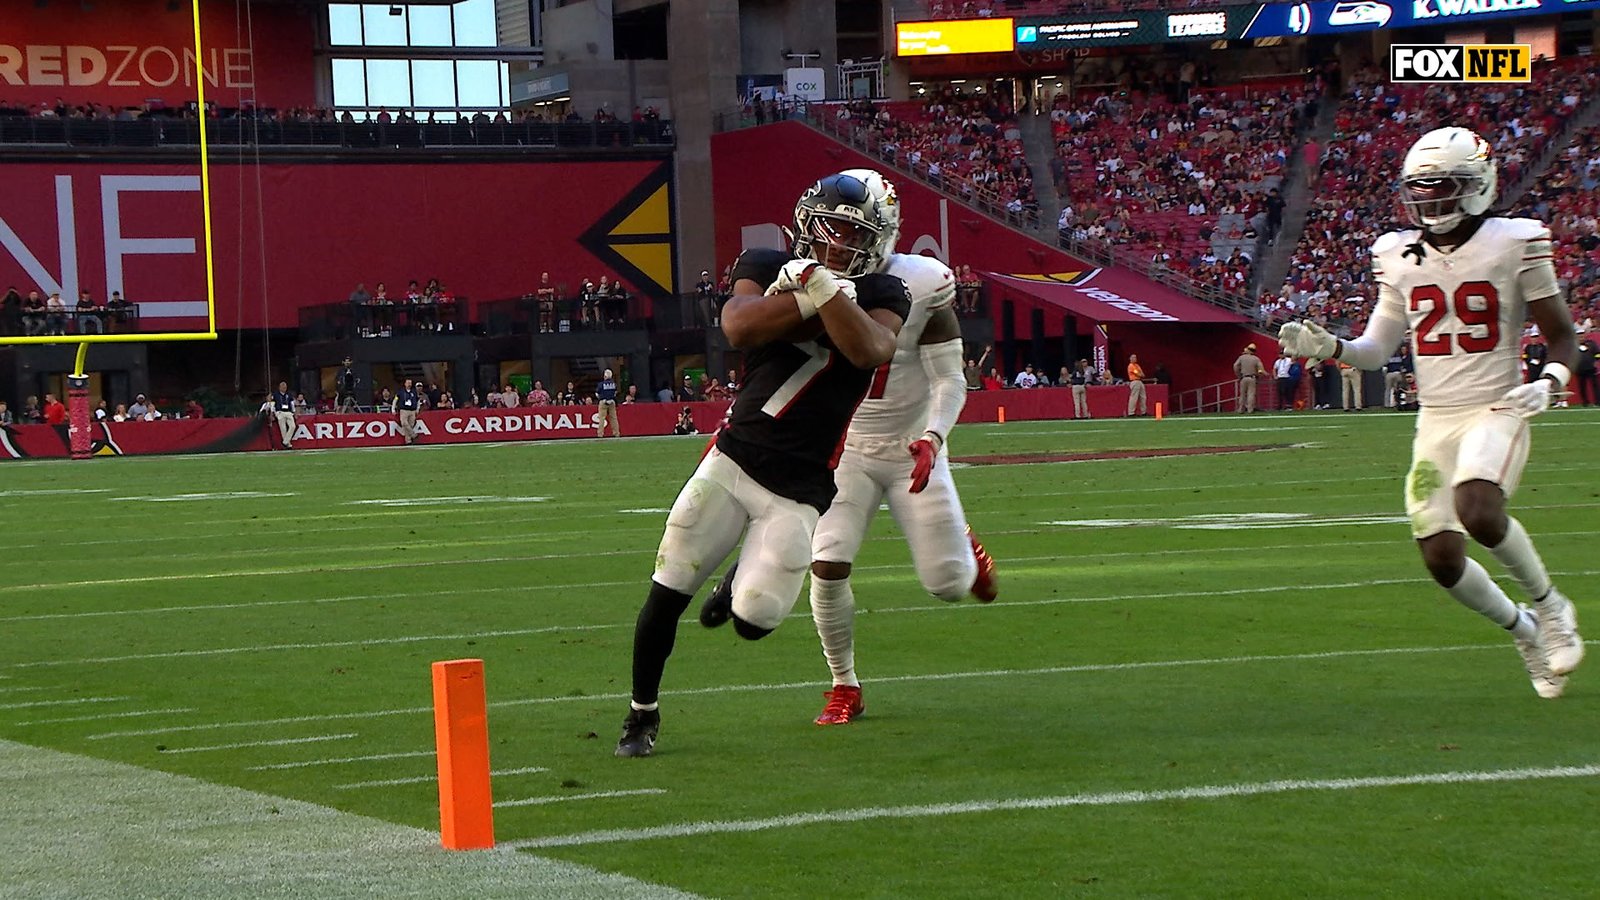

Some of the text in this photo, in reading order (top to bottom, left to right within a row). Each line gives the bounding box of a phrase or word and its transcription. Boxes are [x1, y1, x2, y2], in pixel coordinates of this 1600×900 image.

[1288, 3, 1311, 34] 4)
[0, 45, 255, 88] REDZONE
[796, 82, 817, 91] COX
[843, 205, 860, 215] ATL
[1074, 287, 1180, 321] verizon
[1410, 280, 1500, 356] 29
[761, 340, 833, 420] 7
[293, 411, 609, 441] ARIZONA CARDINALS
